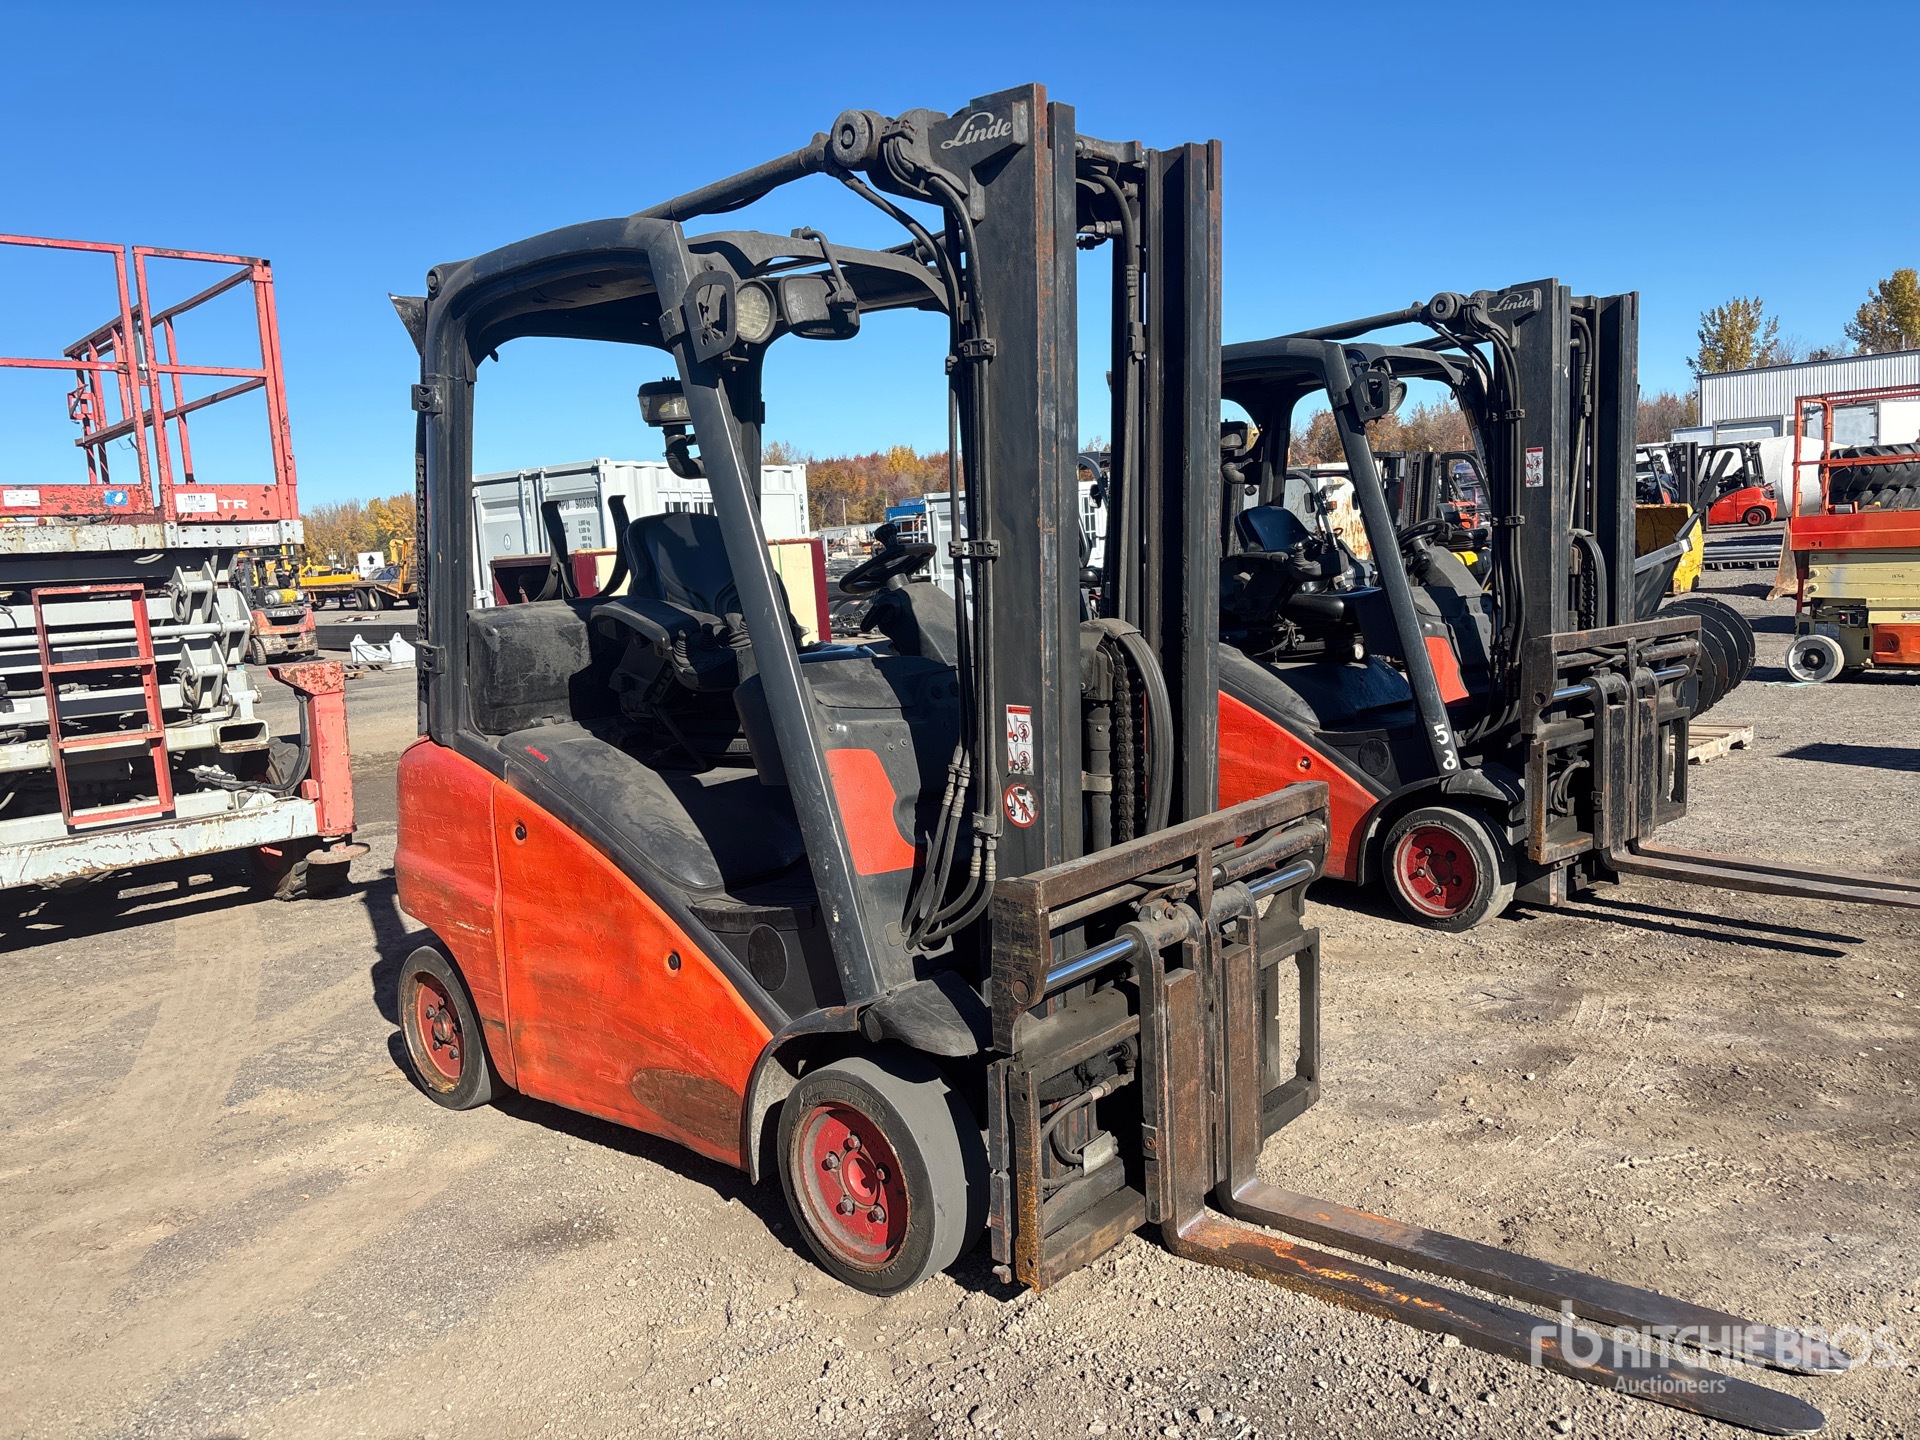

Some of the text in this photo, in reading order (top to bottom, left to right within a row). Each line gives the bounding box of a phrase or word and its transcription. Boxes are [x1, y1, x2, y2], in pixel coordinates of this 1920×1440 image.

[940, 111, 1012, 150] Linde
[1487, 293, 1534, 313] Linde
[218, 499, 248, 509] TR
